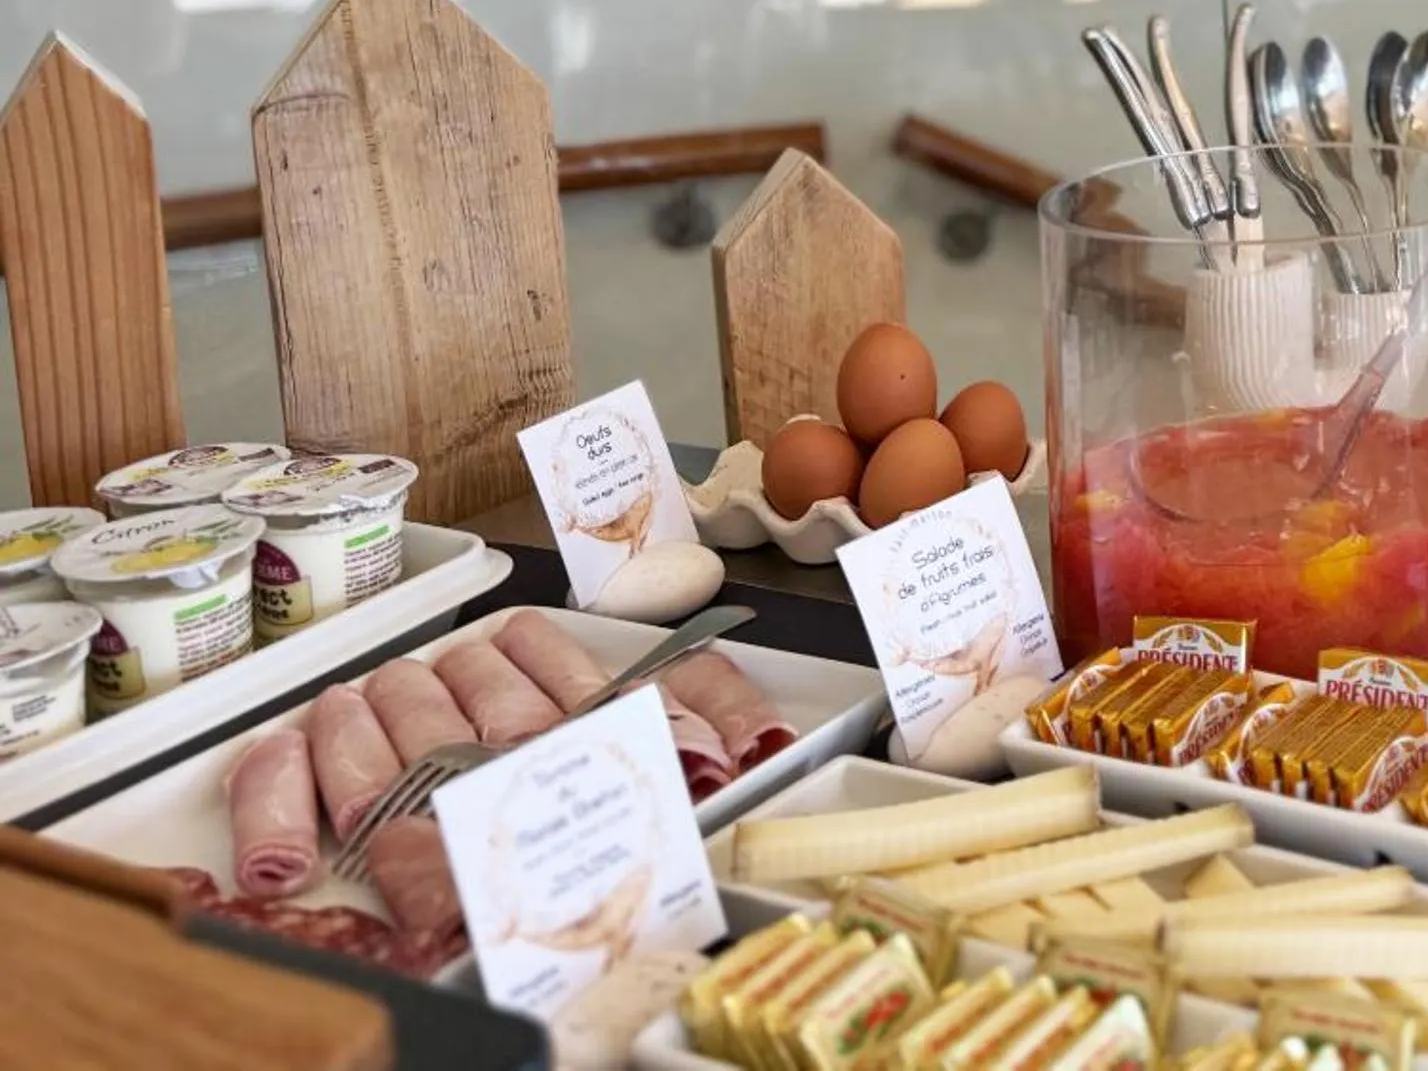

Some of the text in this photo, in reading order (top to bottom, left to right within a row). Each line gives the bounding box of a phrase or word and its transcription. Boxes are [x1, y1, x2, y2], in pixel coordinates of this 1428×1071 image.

[911, 536, 964, 569] Salade
[898, 581, 917, 599] de
[920, 561, 959, 589] fruits
